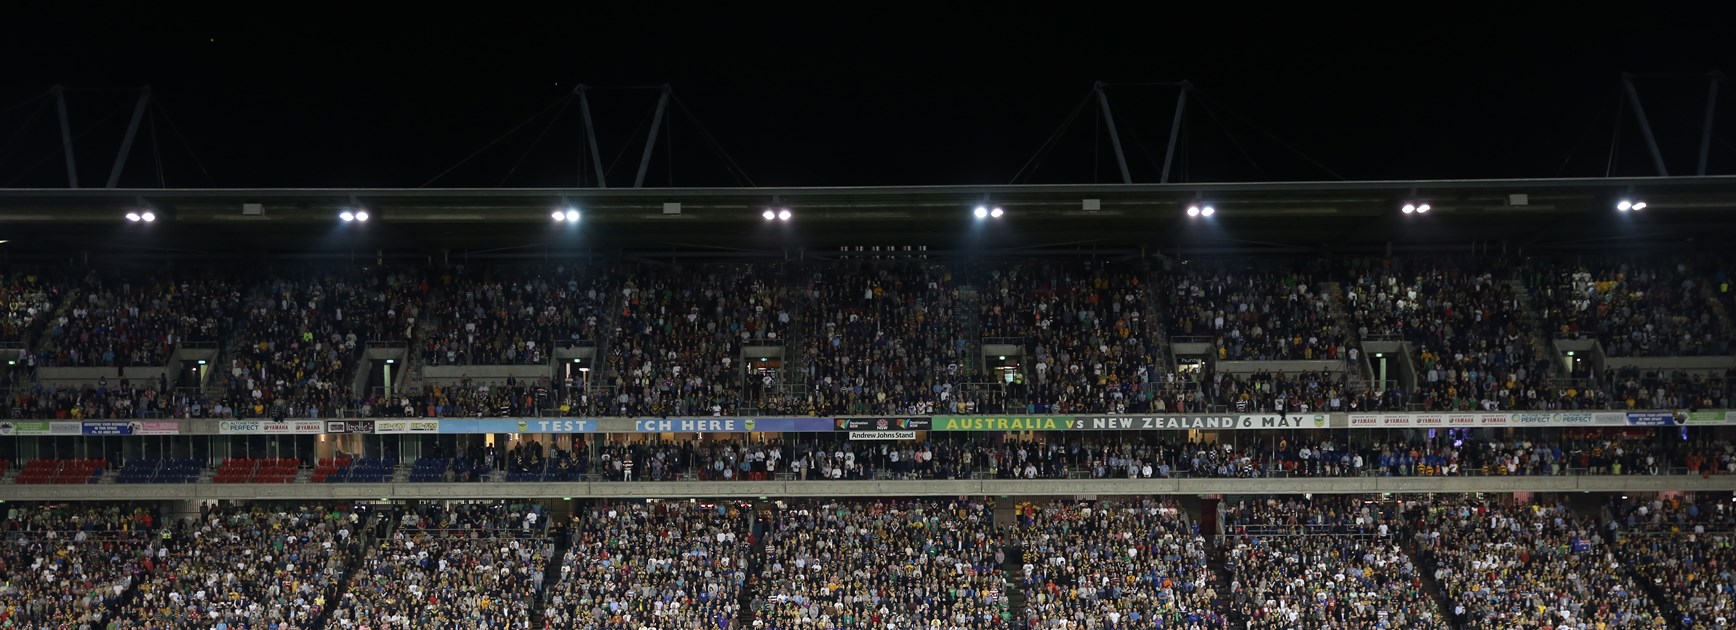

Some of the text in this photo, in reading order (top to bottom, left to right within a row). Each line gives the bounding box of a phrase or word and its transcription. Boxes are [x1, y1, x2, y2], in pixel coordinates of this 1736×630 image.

[538, 421, 587, 431] TEST
[681, 420, 734, 431] HERE
[946, 418, 1056, 429] AUSTRALIA
[1093, 417, 1133, 429] NEW
[1142, 417, 1233, 429] ZEALAND
[1243, 416, 1304, 427] 6 MAY
